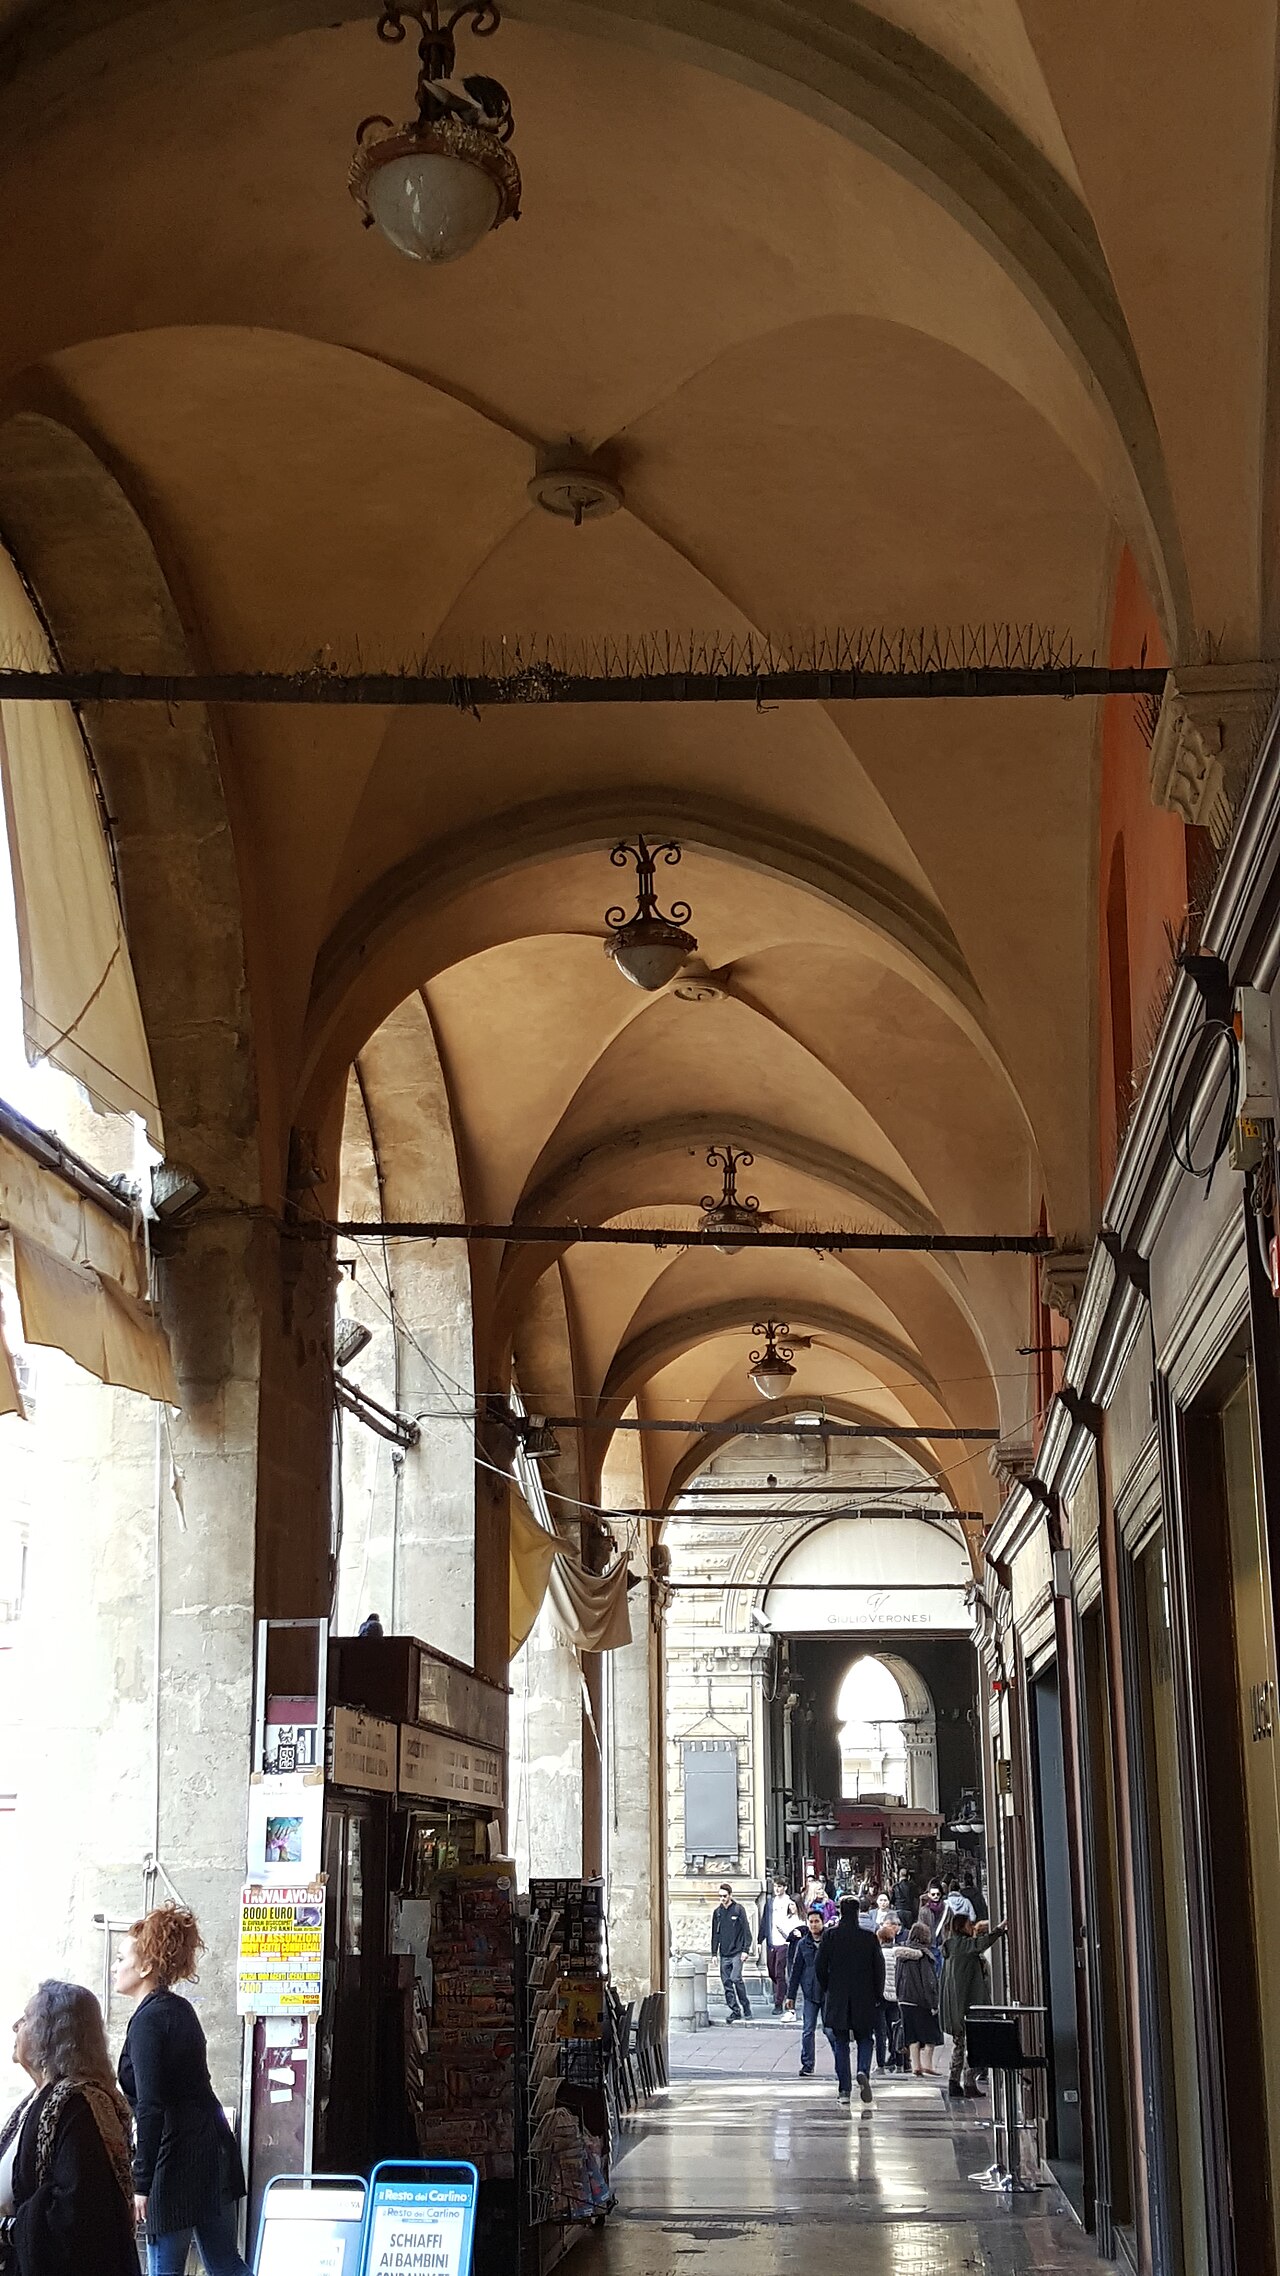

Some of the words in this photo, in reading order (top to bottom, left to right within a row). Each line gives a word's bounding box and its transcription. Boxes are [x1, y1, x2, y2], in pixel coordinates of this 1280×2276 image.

[243, 1906, 268, 1920] 8000
[270, 1906, 293, 1920] EURO
[385, 2189, 414, 2201] Resto
[414, 2192, 428, 2202] del
[428, 2190, 468, 2203] Carlino
[387, 2207, 412, 2217] Resto
[427, 2208, 460, 2218] Carlino
[390, 2233, 443, 2248] SCHIAFFI
[379, 2252, 393, 2267] AI
[395, 2252, 449, 2268] BAMBINI
